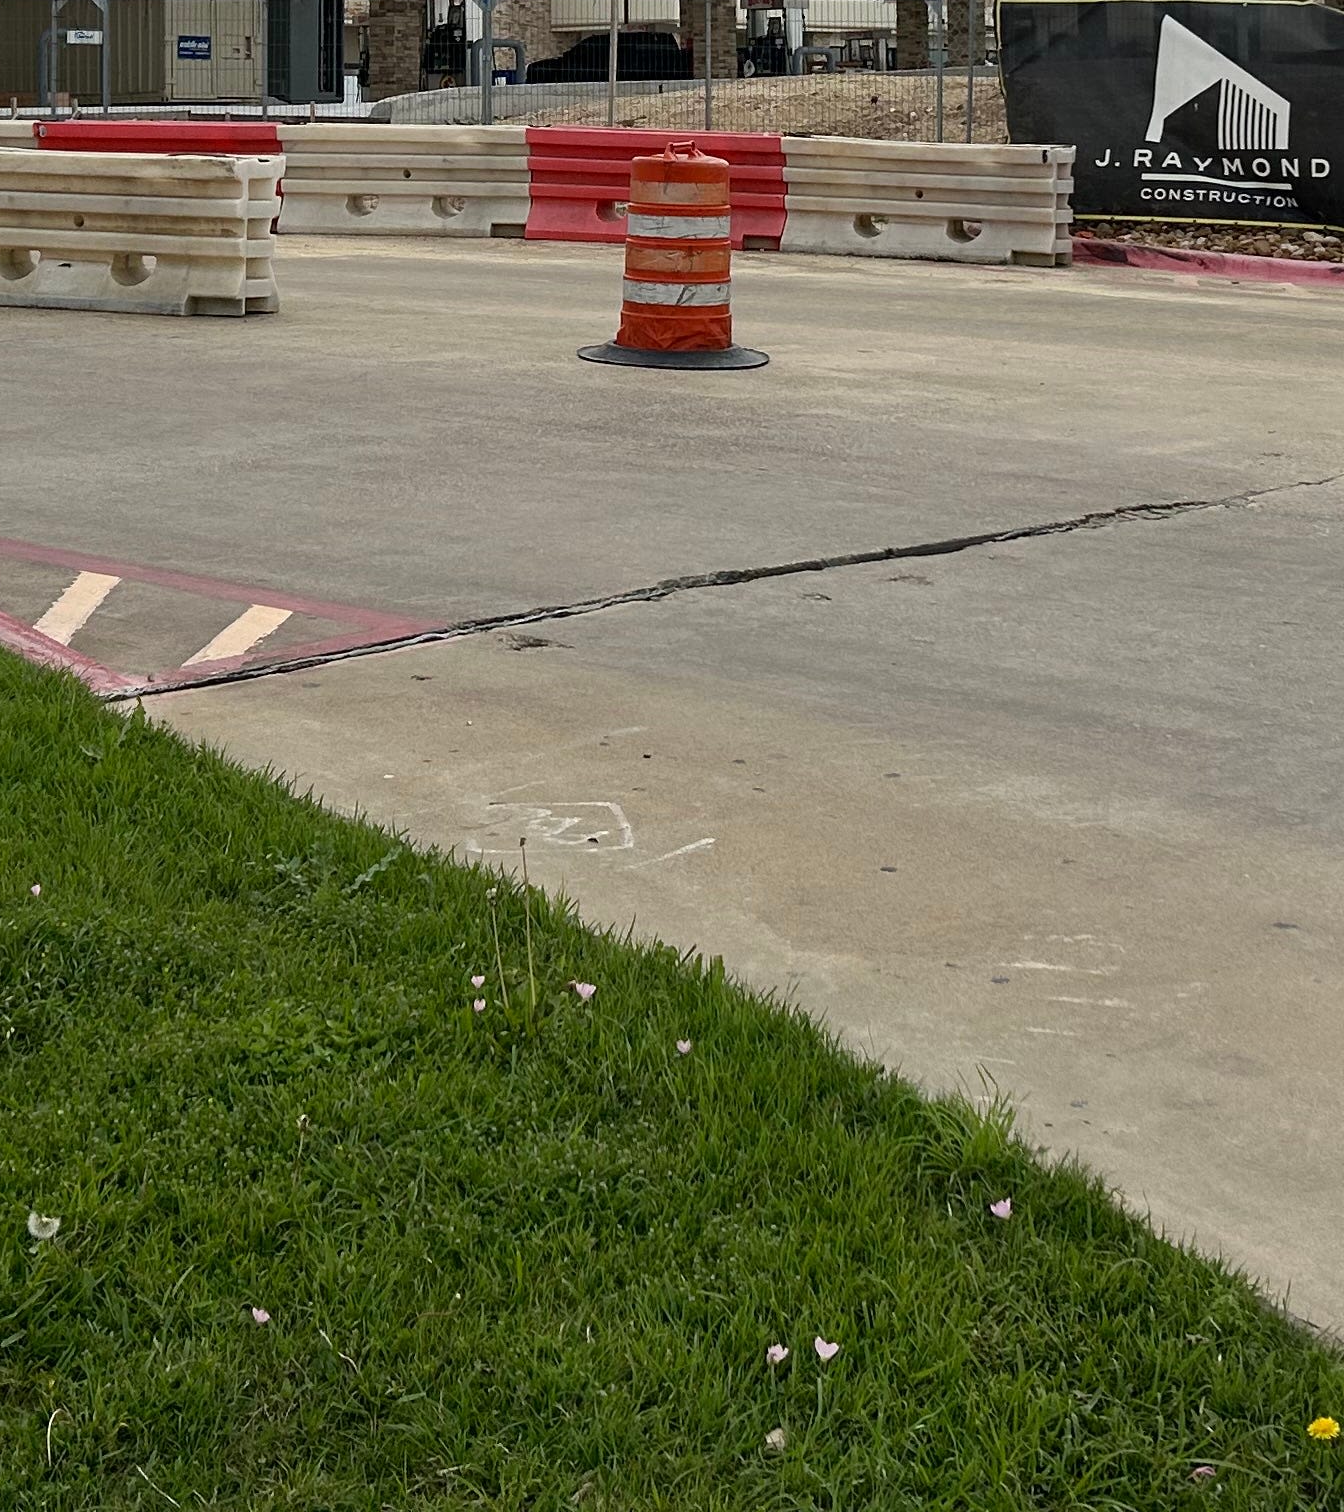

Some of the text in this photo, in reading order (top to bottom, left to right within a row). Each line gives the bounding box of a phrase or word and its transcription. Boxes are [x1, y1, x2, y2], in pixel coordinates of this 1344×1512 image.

[1095, 148, 1331, 178] J. RAYMOND
[1140, 188, 1299, 207] CONSTRUCTION
